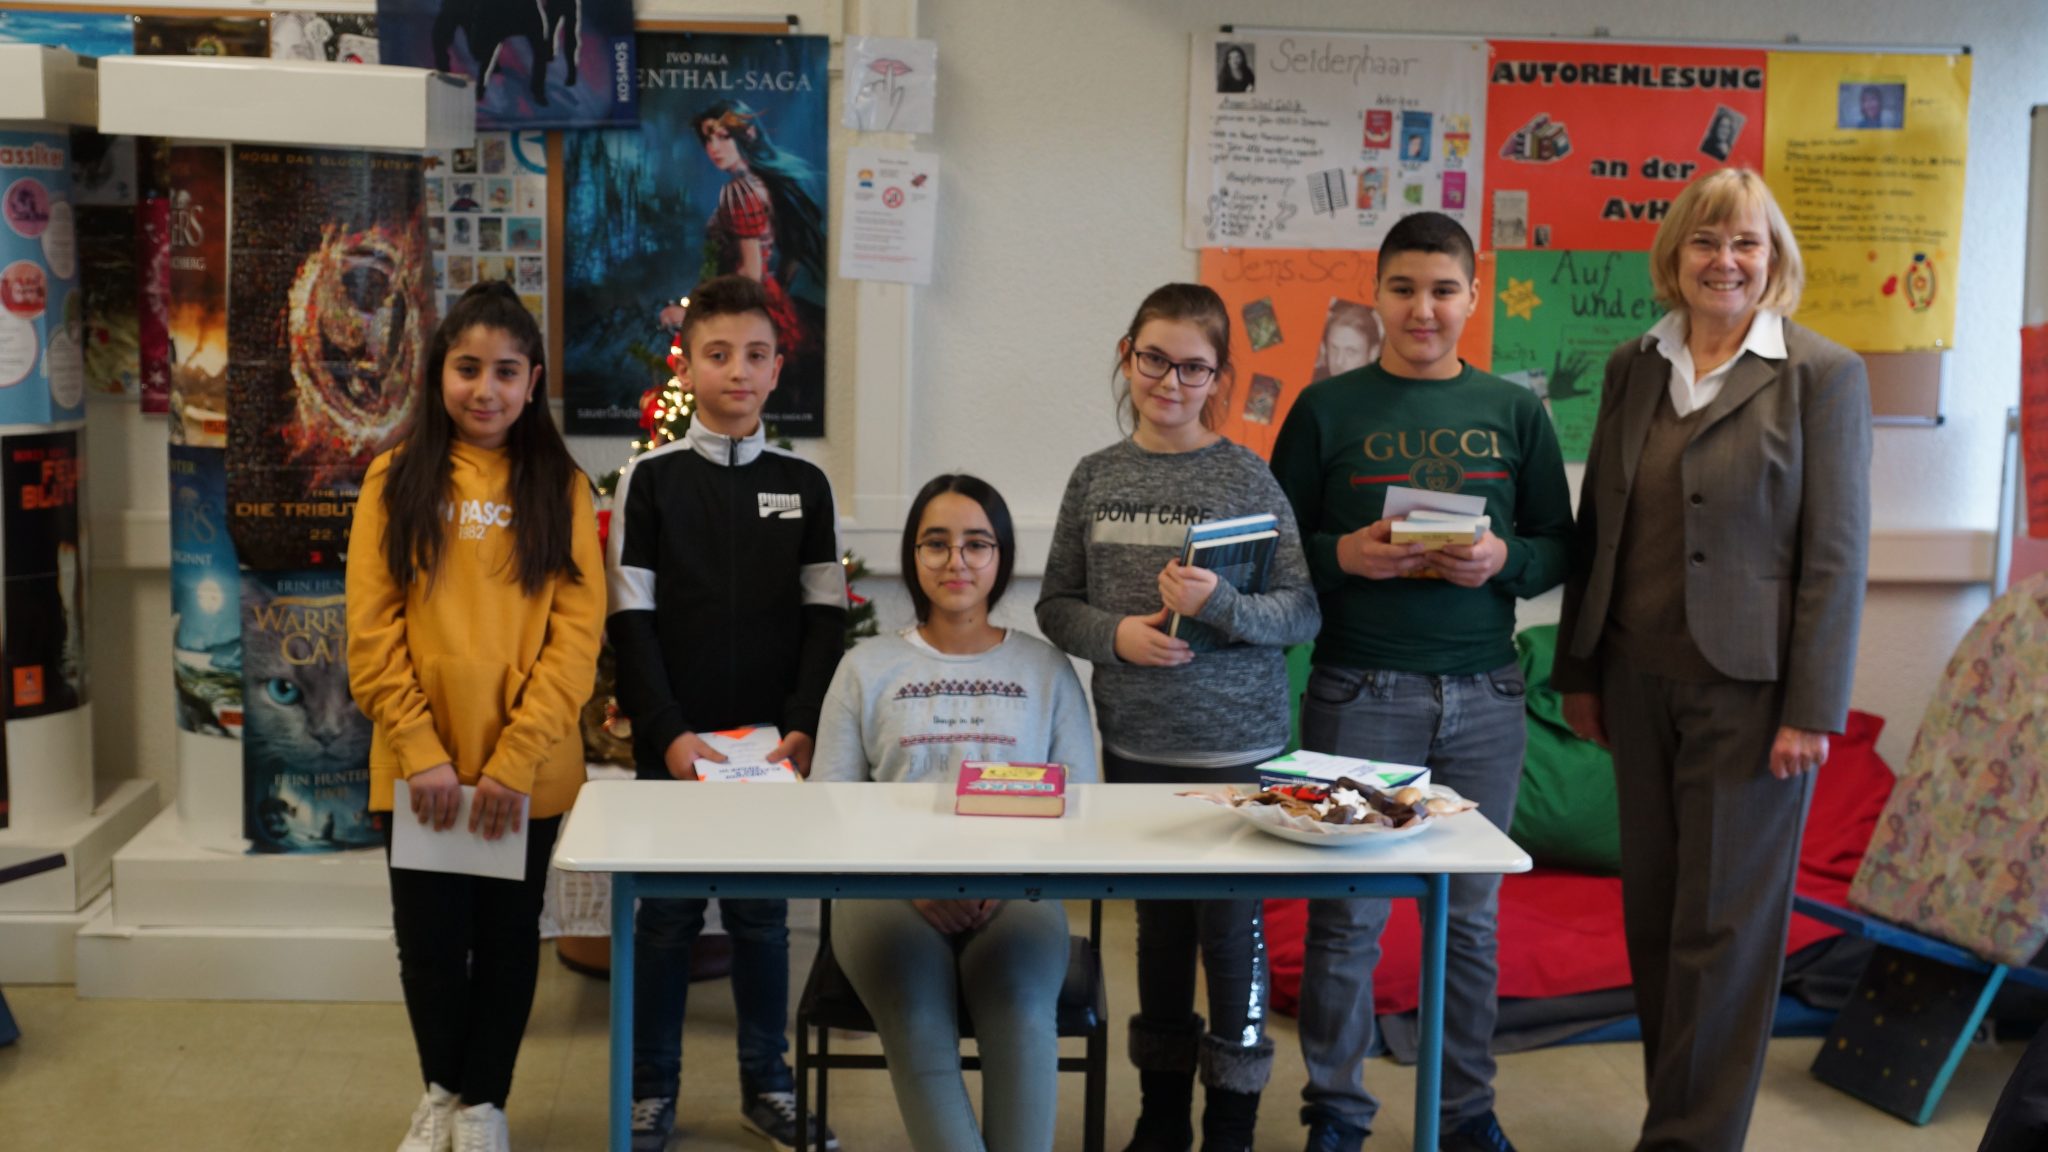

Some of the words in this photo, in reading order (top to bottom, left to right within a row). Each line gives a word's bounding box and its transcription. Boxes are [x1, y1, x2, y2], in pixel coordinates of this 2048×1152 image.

[615, 42, 630, 102] KOSMOS
[666, 52, 690, 64] IVO
[694, 52, 729, 65] PALA
[1490, 61, 1764, 91] AUTORENLESUNG
[1590, 158, 1630, 179] an
[1641, 156, 1697, 181] der
[1551, 250, 1622, 296] Auf
[1363, 428, 1503, 461] GUCCI
[235, 502, 275, 518] DIE
[281, 502, 357, 518] TRIBUT
[1095, 502, 1154, 525] DON'T
[1157, 504, 1214, 527] CARE
[281, 632, 347, 666] CAT
